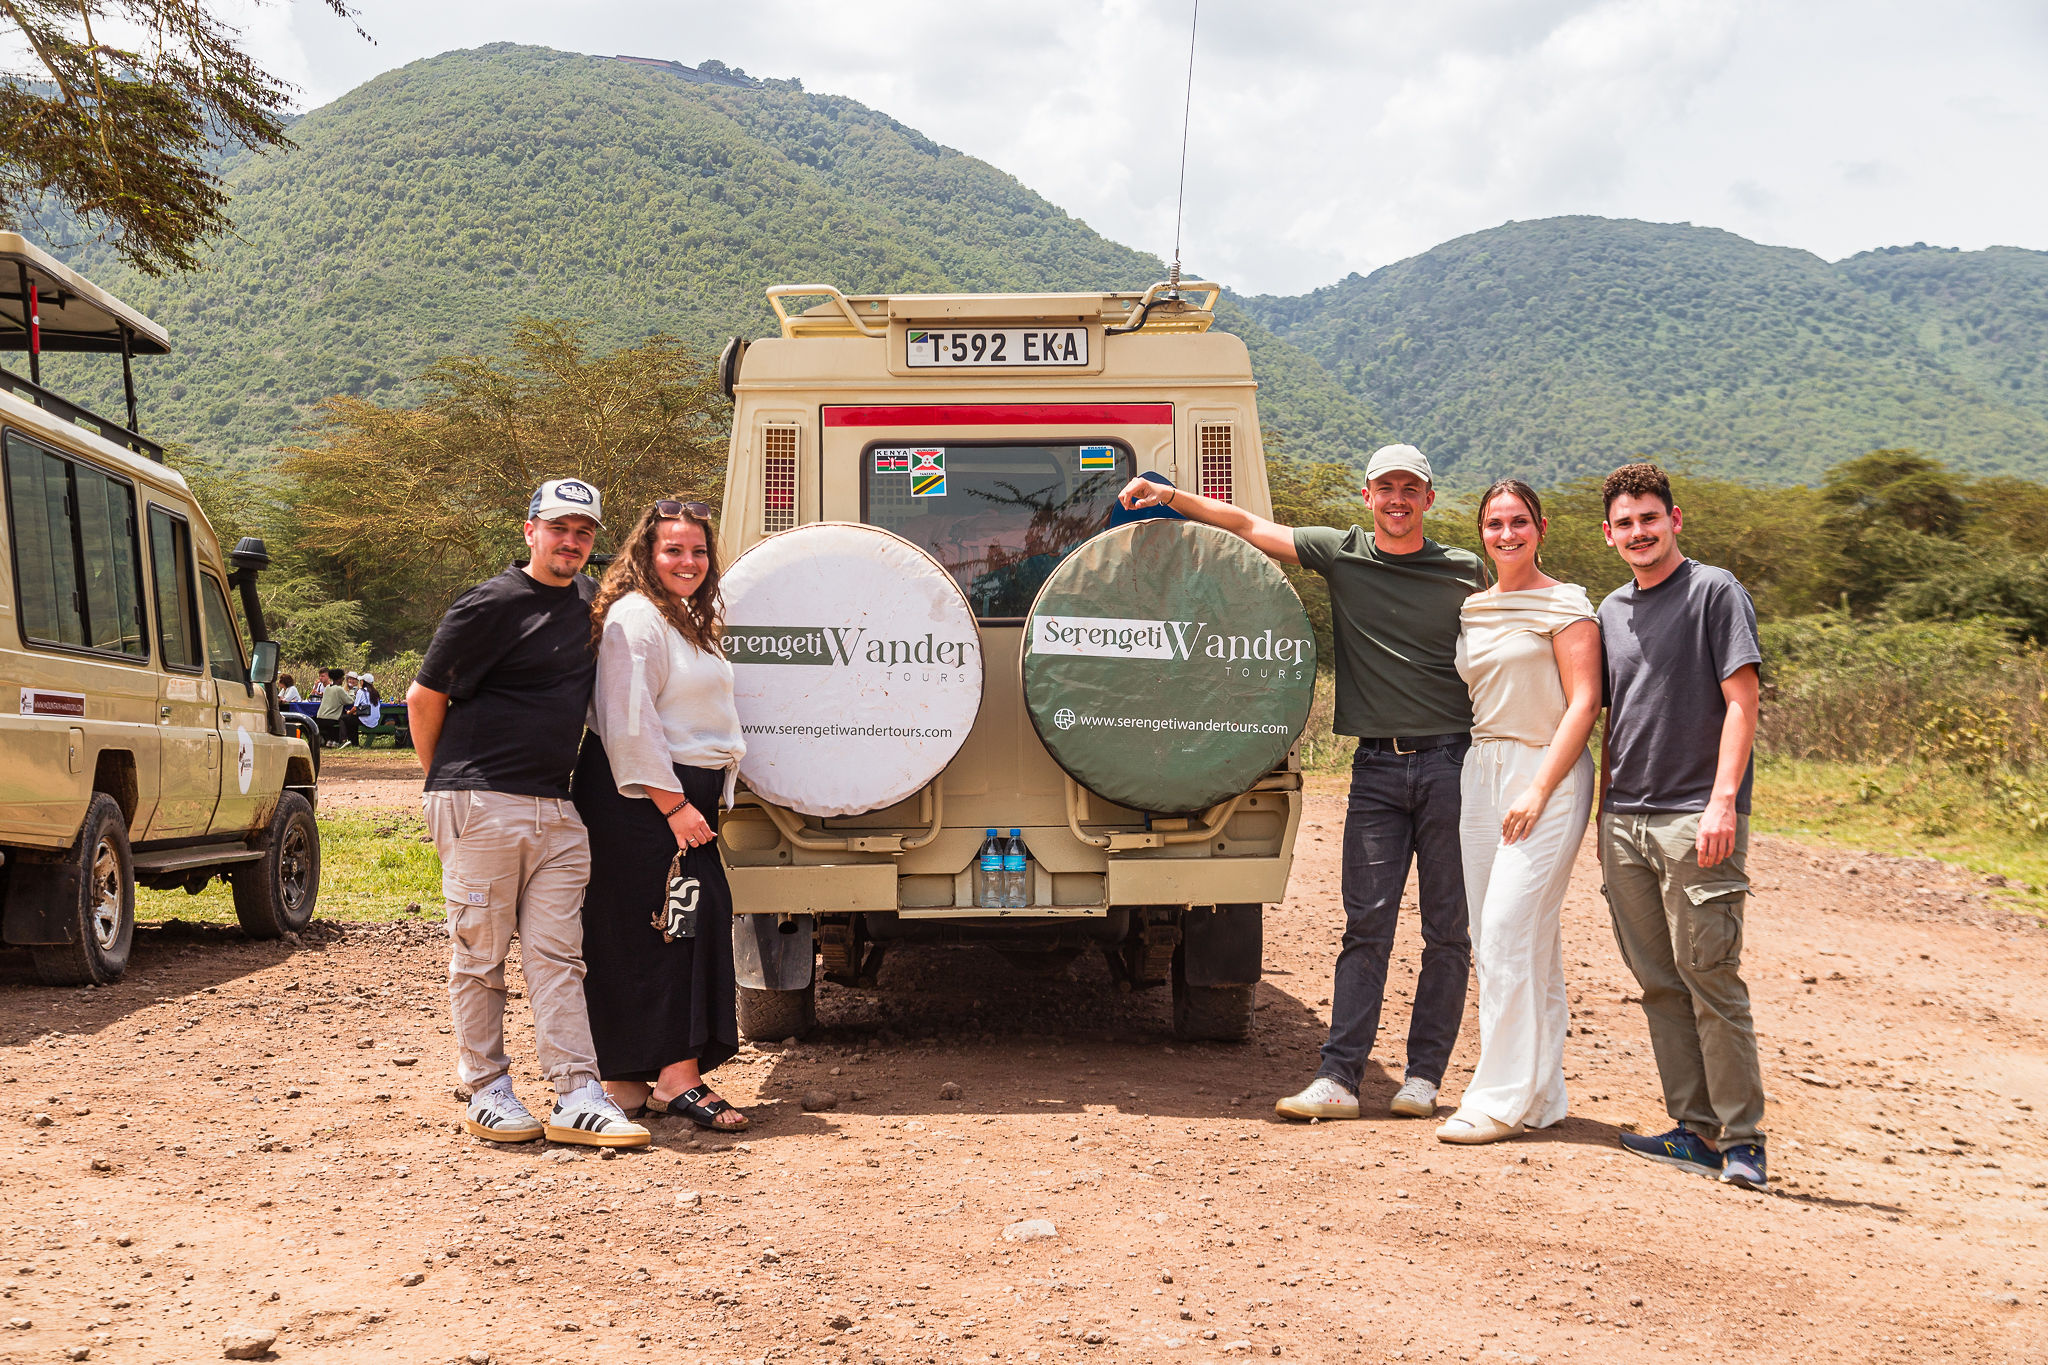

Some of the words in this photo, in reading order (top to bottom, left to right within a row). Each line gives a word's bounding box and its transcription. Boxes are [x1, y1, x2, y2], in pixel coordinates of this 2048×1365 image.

[1023, 332, 1079, 361] EKA
[721, 632, 823, 660] erengeti
[823, 627, 975, 668] Wander
[1044, 620, 1163, 653] Serengeti
[1163, 621, 1311, 666] Wander
[886, 671, 966, 683] TOURS
[1225, 667, 1303, 680] TOURS
[741, 723, 953, 738] www.serengetiwandertours.com
[1080, 714, 1289, 735] www.serengetiwandertours.com
